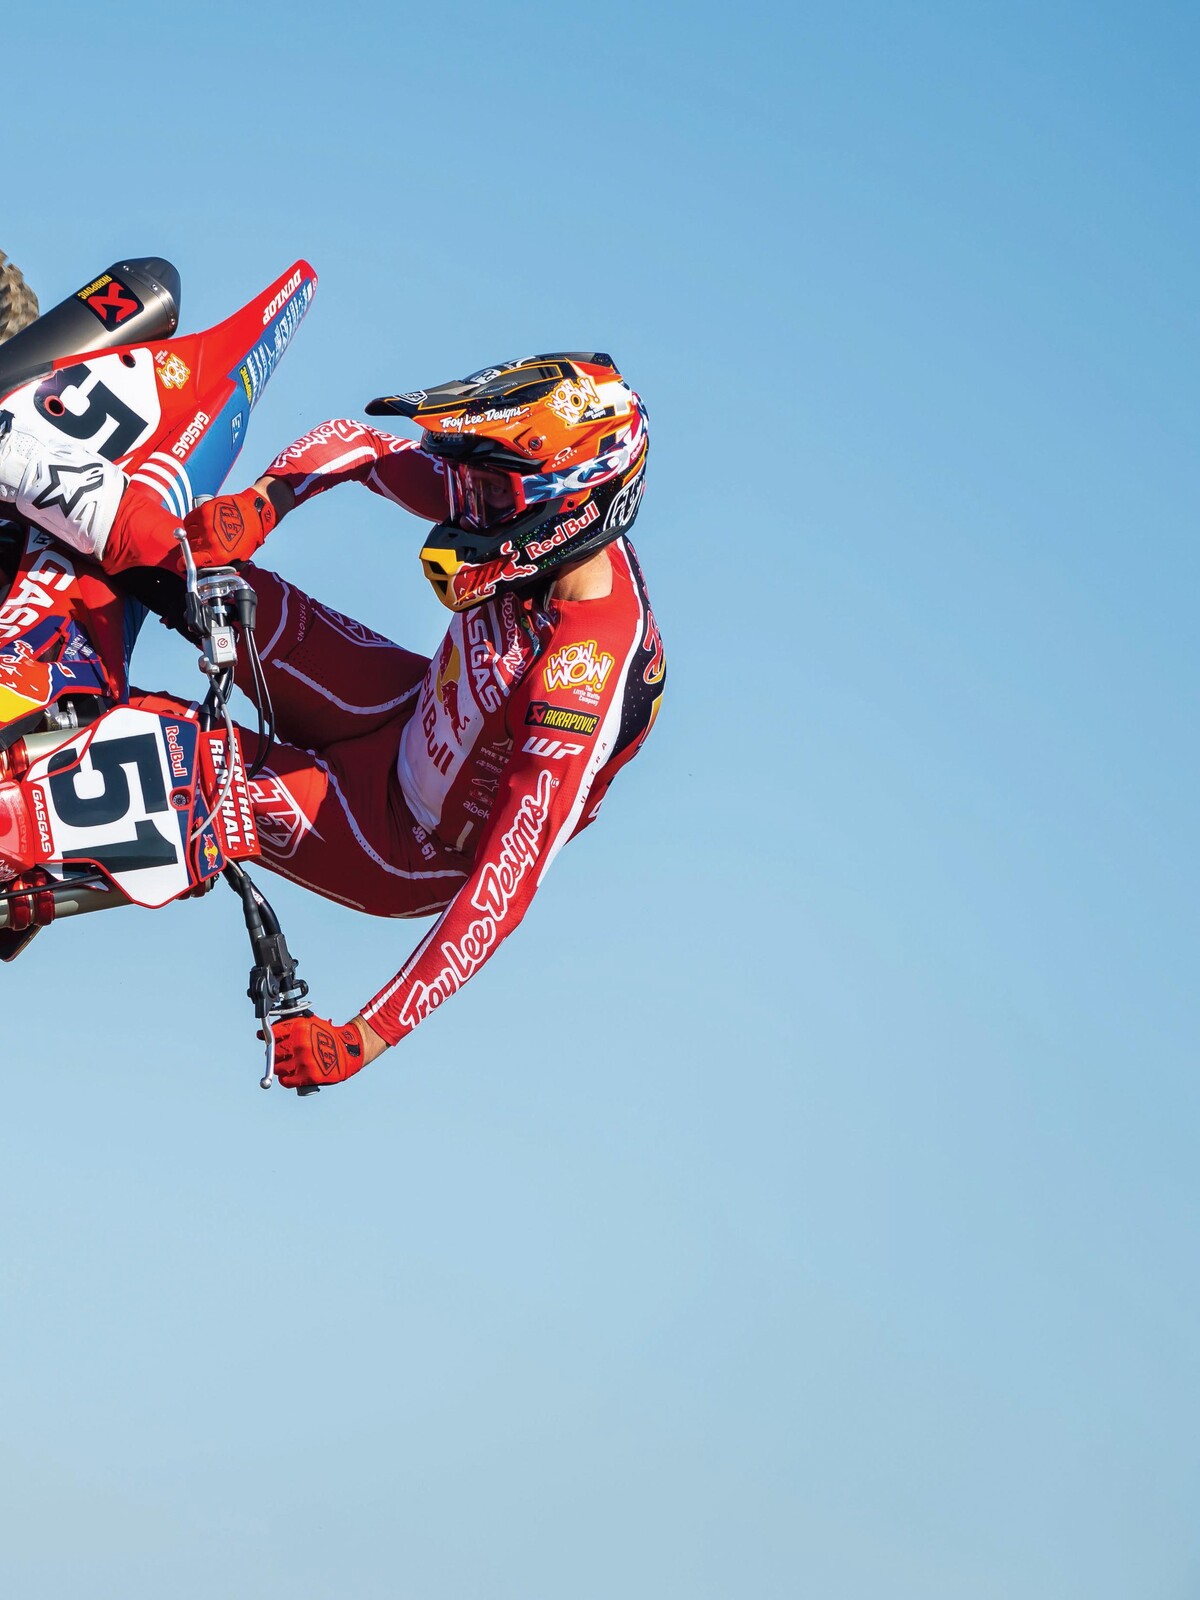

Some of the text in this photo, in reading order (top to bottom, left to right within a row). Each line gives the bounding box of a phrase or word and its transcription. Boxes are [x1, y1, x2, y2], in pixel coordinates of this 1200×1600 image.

[263, 269, 302, 326] DUNLOP
[171, 411, 210, 458] GASGAS
[440, 406, 530, 433] Troy Lee Designs
[525, 524, 568, 560] Red
[561, 500, 601, 539] Bull
[546, 655, 613, 690] WOW!
[551, 643, 594, 670] WOW
[165, 726, 188, 777] Red Bull
[522, 736, 585, 760] WP
[32, 789, 52, 853] GASGAS
[47, 732, 178, 879] 51
[463, 799, 490, 820] albek
[399, 967, 463, 1028] Troy
[441, 917, 497, 983] Lee
[471, 769, 552, 922] Designs
